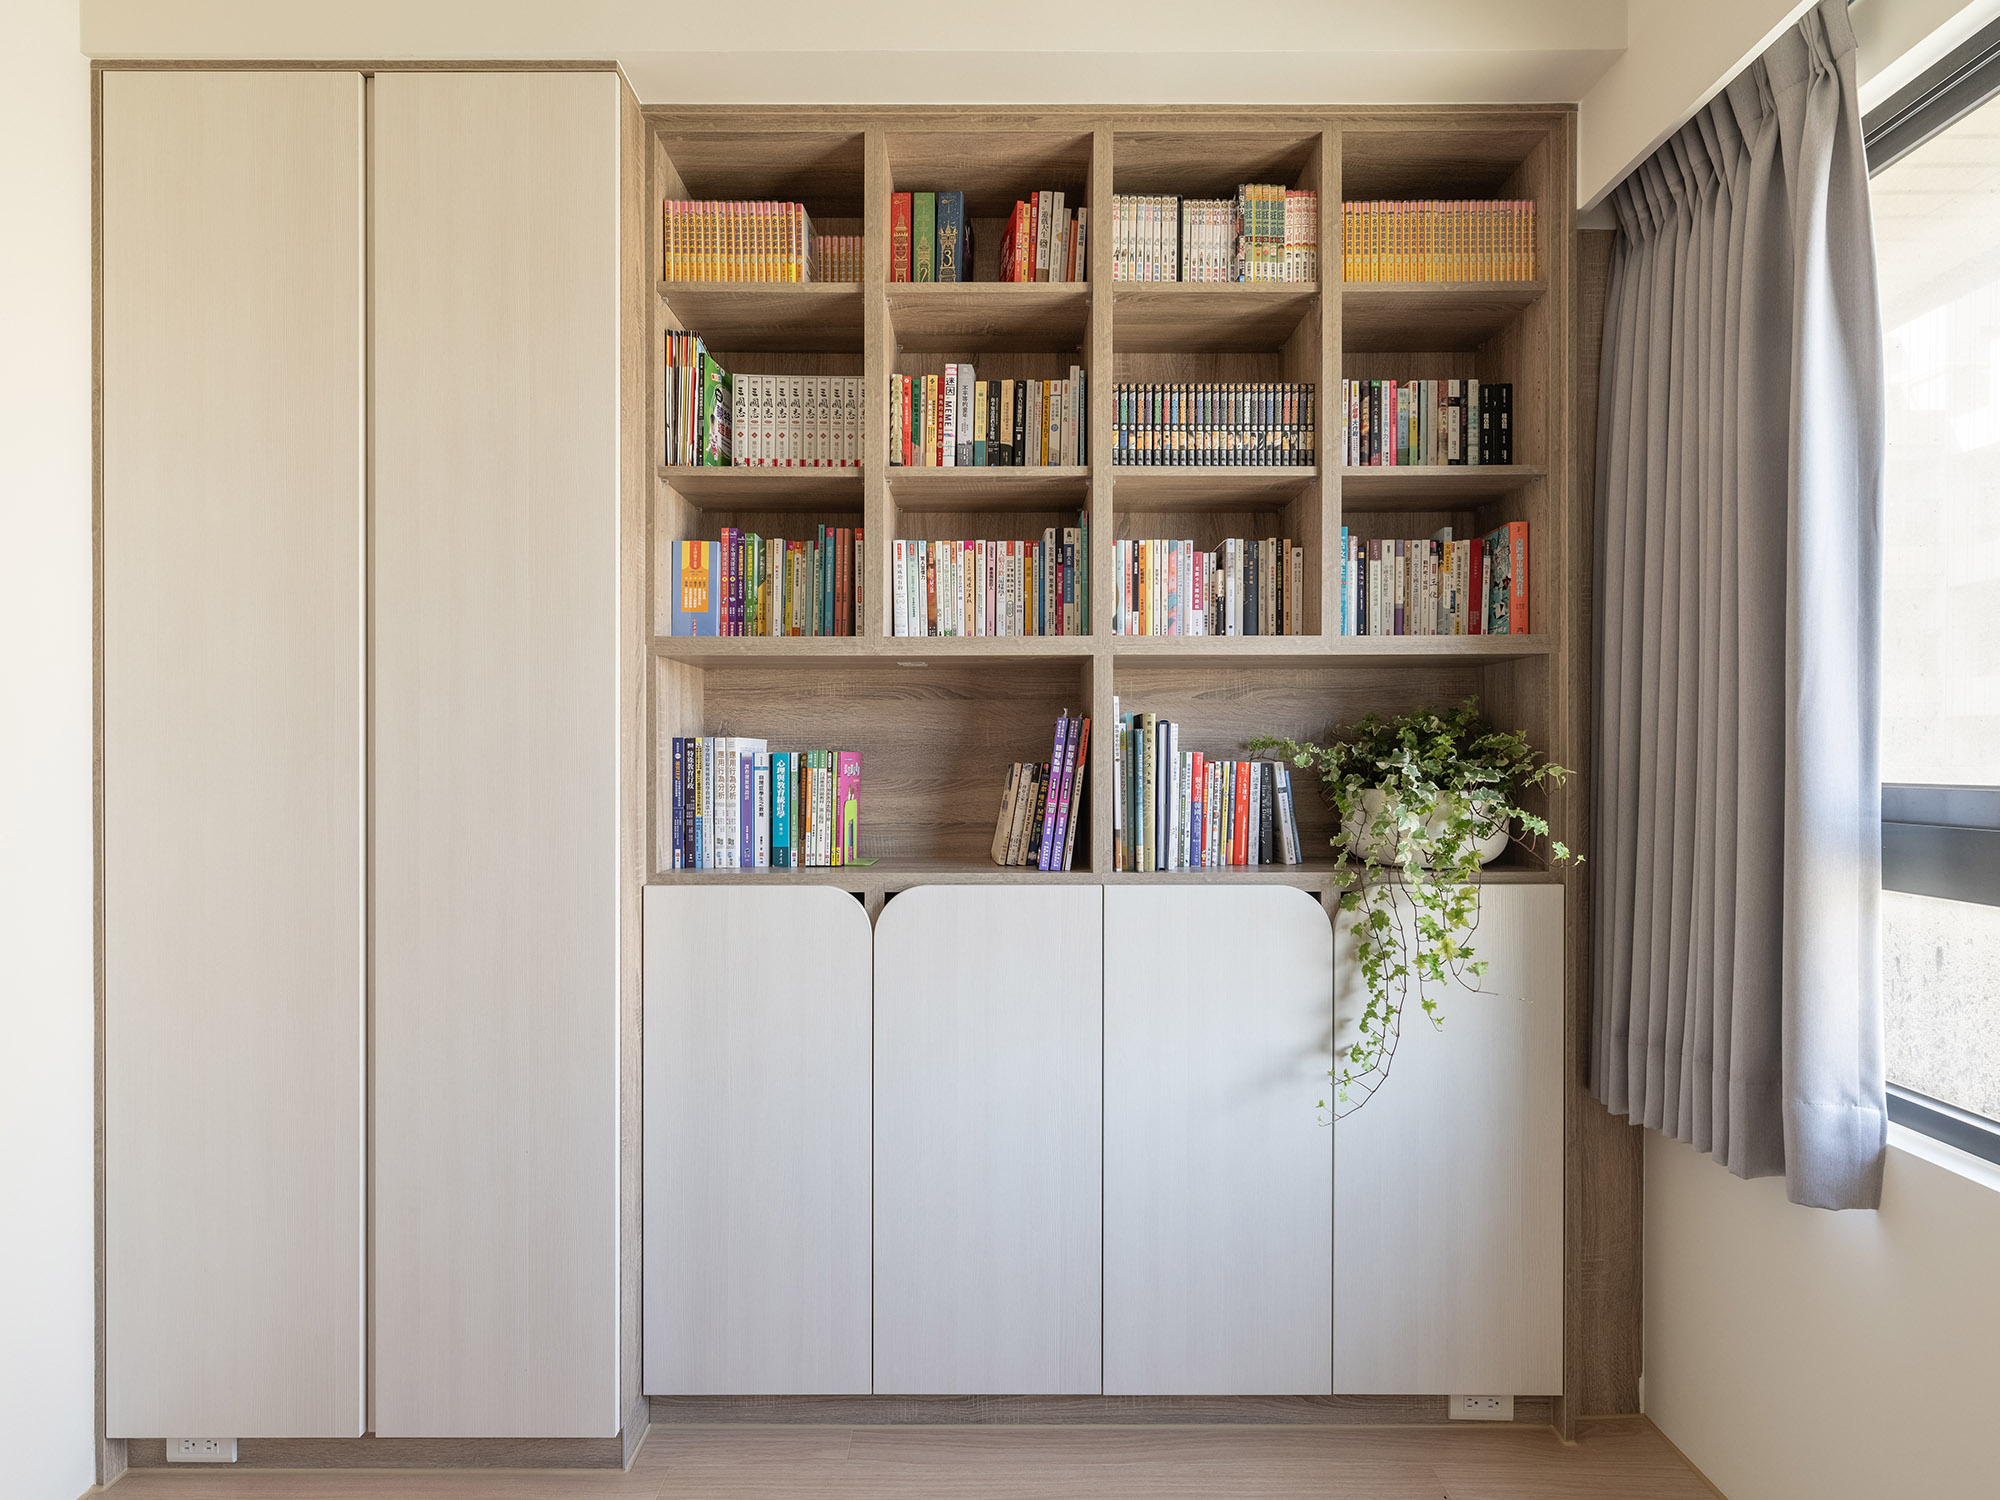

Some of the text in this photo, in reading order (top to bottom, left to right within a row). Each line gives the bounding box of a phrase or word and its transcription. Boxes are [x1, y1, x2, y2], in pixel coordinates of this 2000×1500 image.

[944, 250, 951, 267] 3
[946, 377, 955, 395] 迷因
[736, 387, 746, 418] 三國志
[750, 388, 760, 419] 三國志
[763, 388, 773, 419] 三國志
[777, 388, 787, 419] 三國志
[791, 388, 800, 419] 三國志
[806, 388, 815, 419] 三國志
[819, 388, 828, 419] 三國志
[832, 389, 842, 419] 三國志
[846, 389, 855, 420] 三國志
